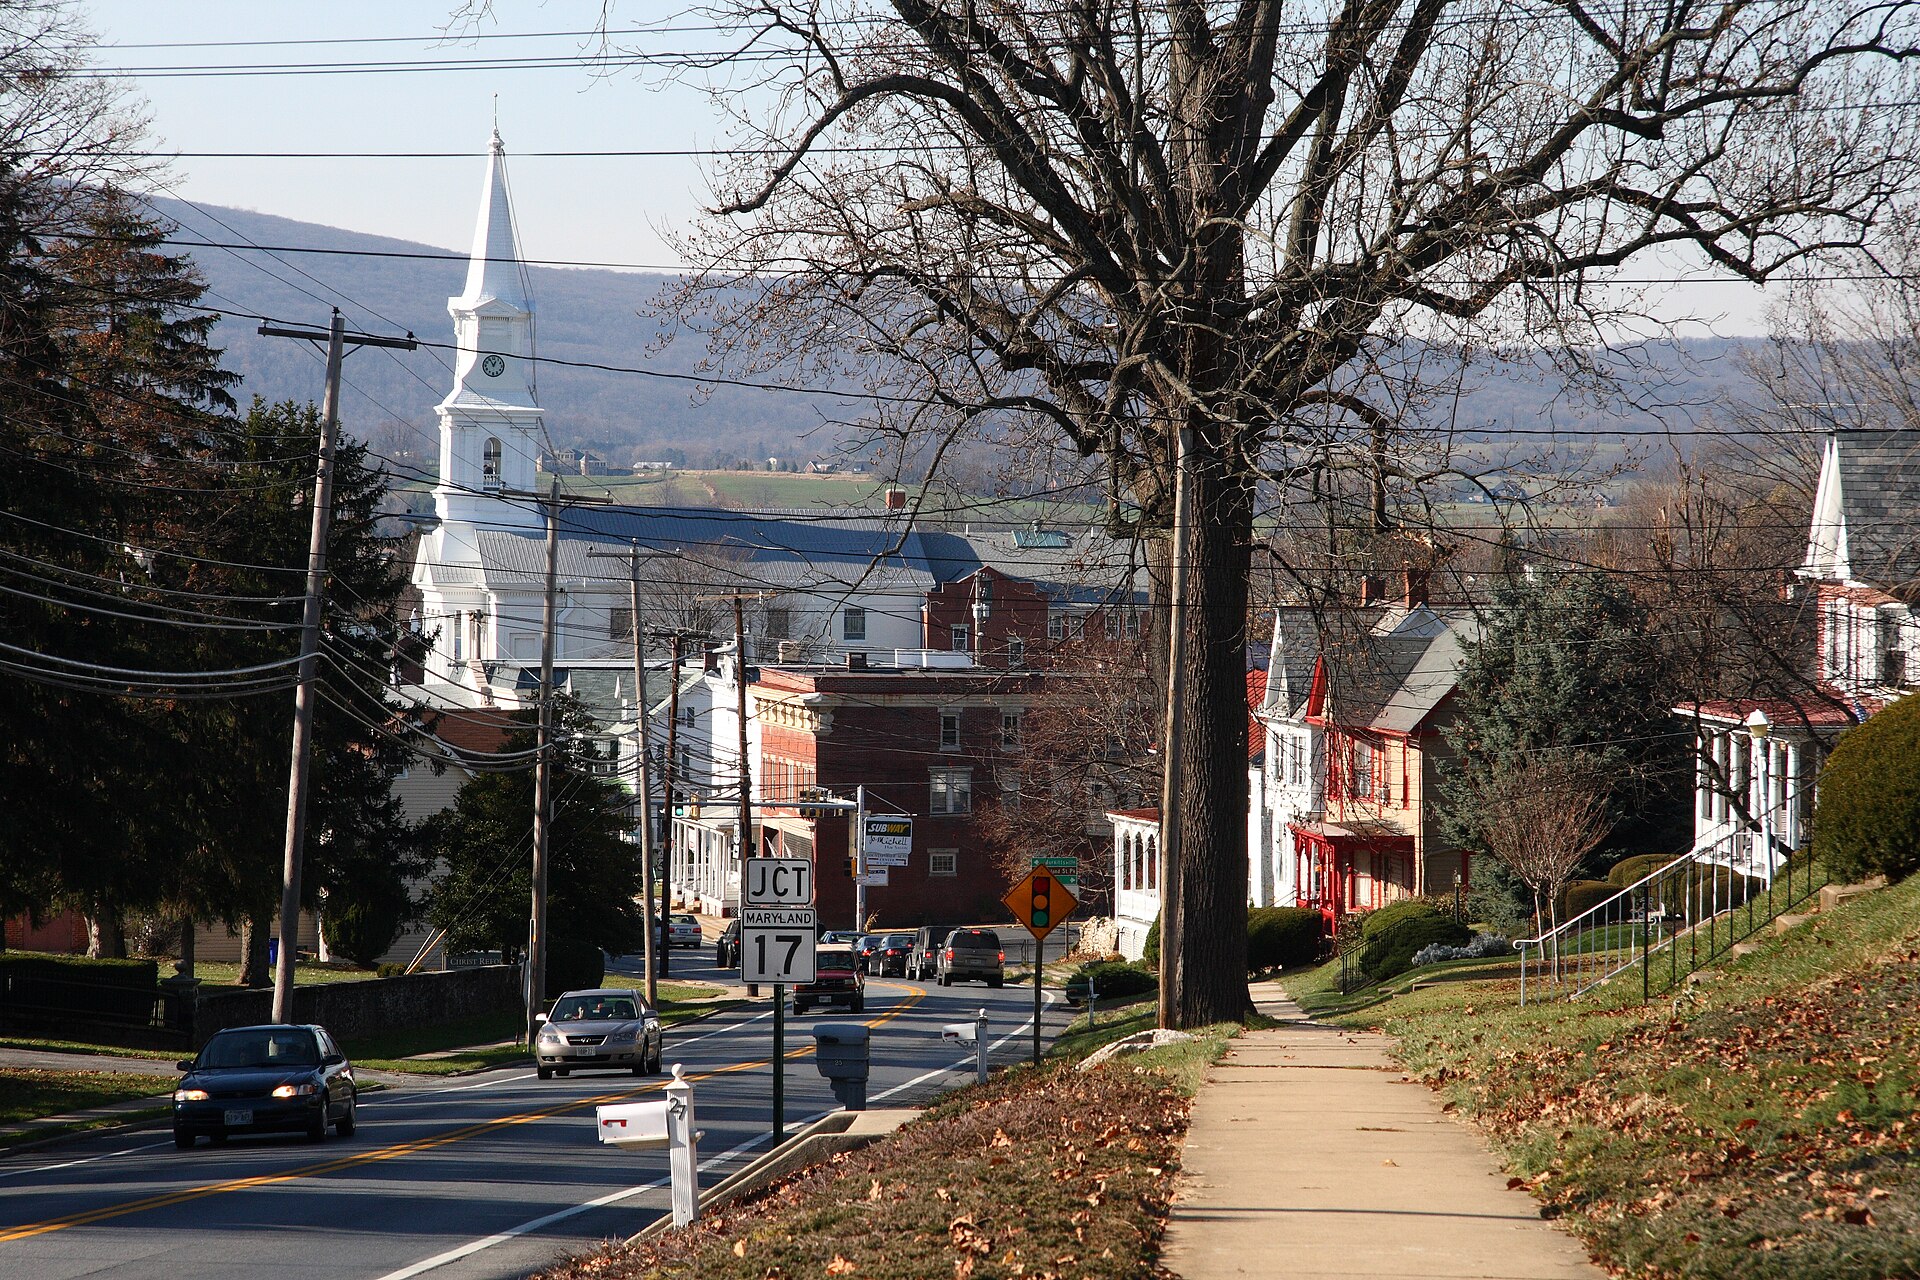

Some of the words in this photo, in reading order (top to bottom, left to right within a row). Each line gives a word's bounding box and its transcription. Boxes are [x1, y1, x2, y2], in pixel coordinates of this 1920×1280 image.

[868, 823, 909, 833] SUBWAY
[751, 866, 807, 897] JCT
[746, 912, 812, 924] MARYLAND
[479, 957, 500, 965] REFO
[754, 934, 803, 975] 17
[669, 1097, 687, 1120] 27
